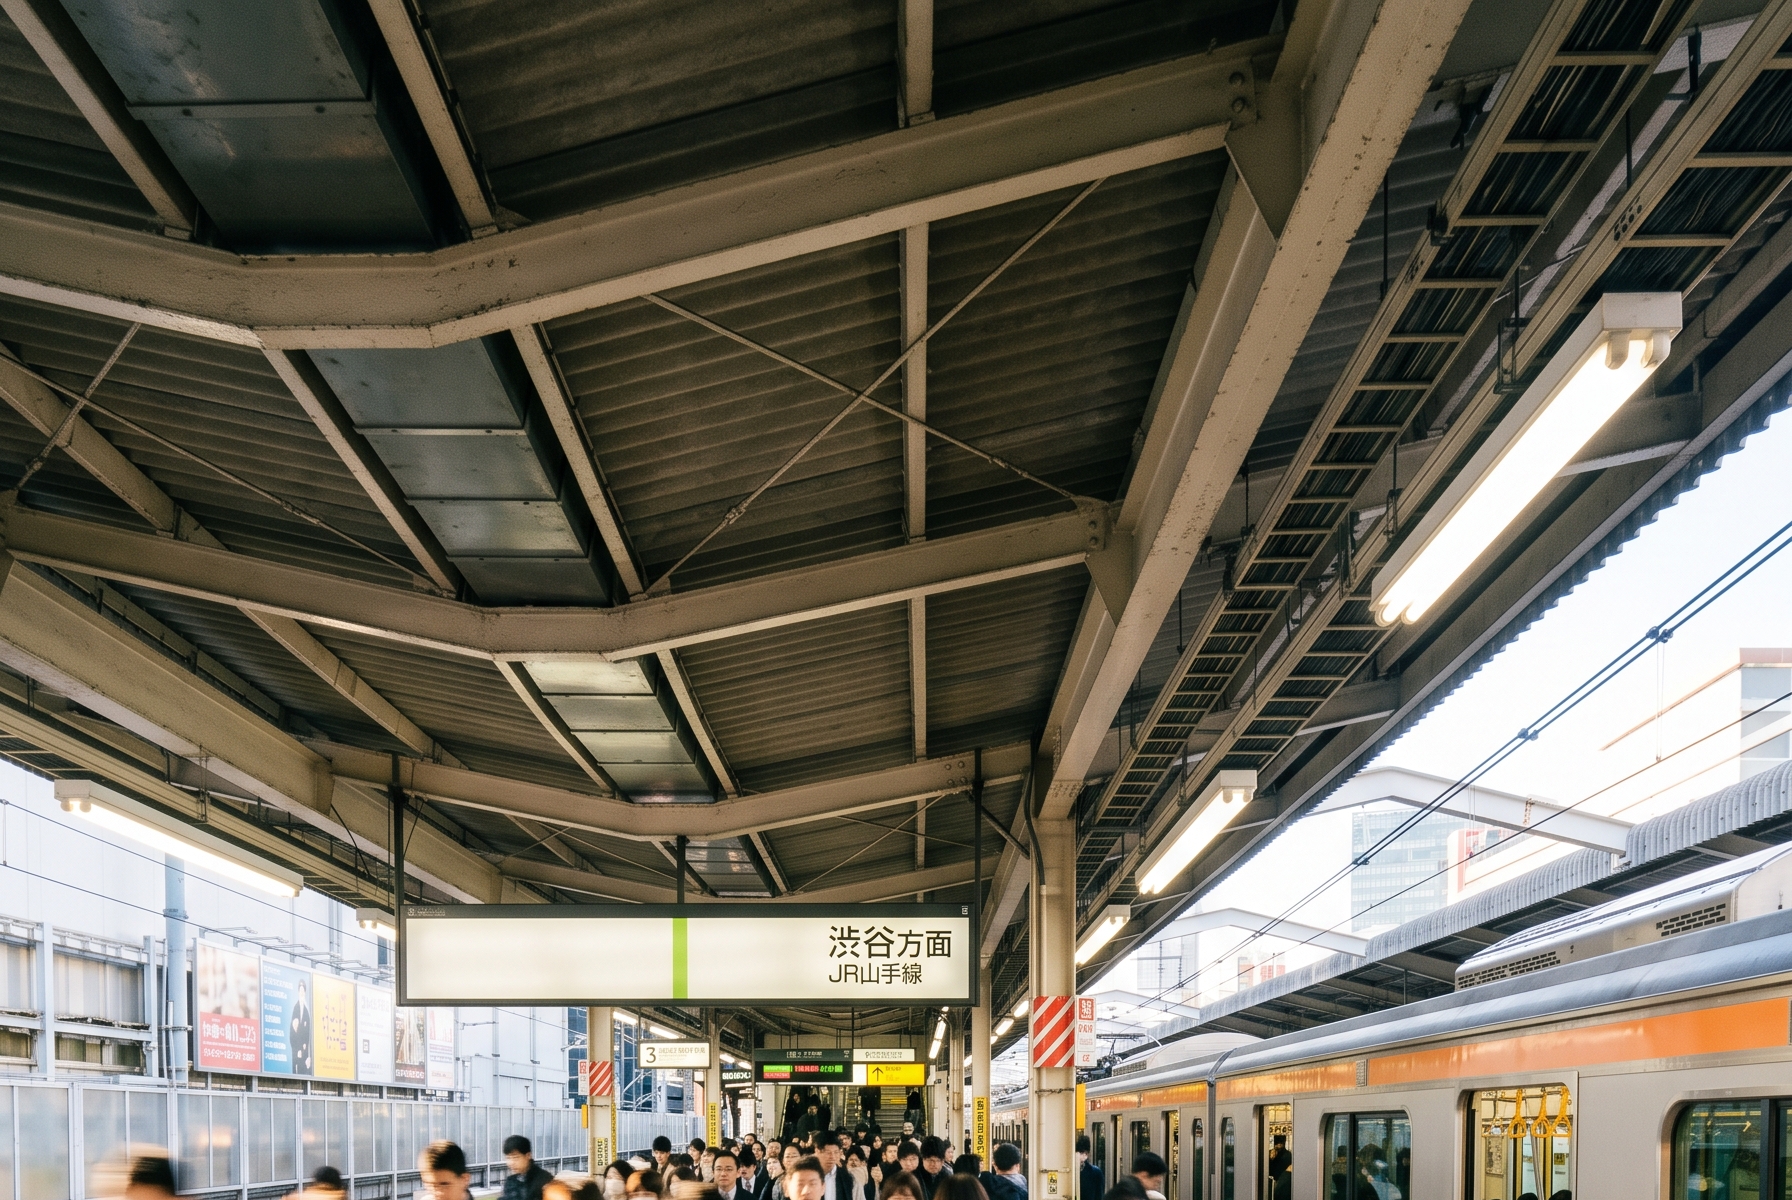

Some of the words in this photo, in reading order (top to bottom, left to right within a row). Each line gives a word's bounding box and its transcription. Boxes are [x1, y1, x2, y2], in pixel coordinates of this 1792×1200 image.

[829, 925, 952, 959] 渋谷方面
[829, 962, 923, 985] JR山手線
[646, 1047, 656, 1063] 3
